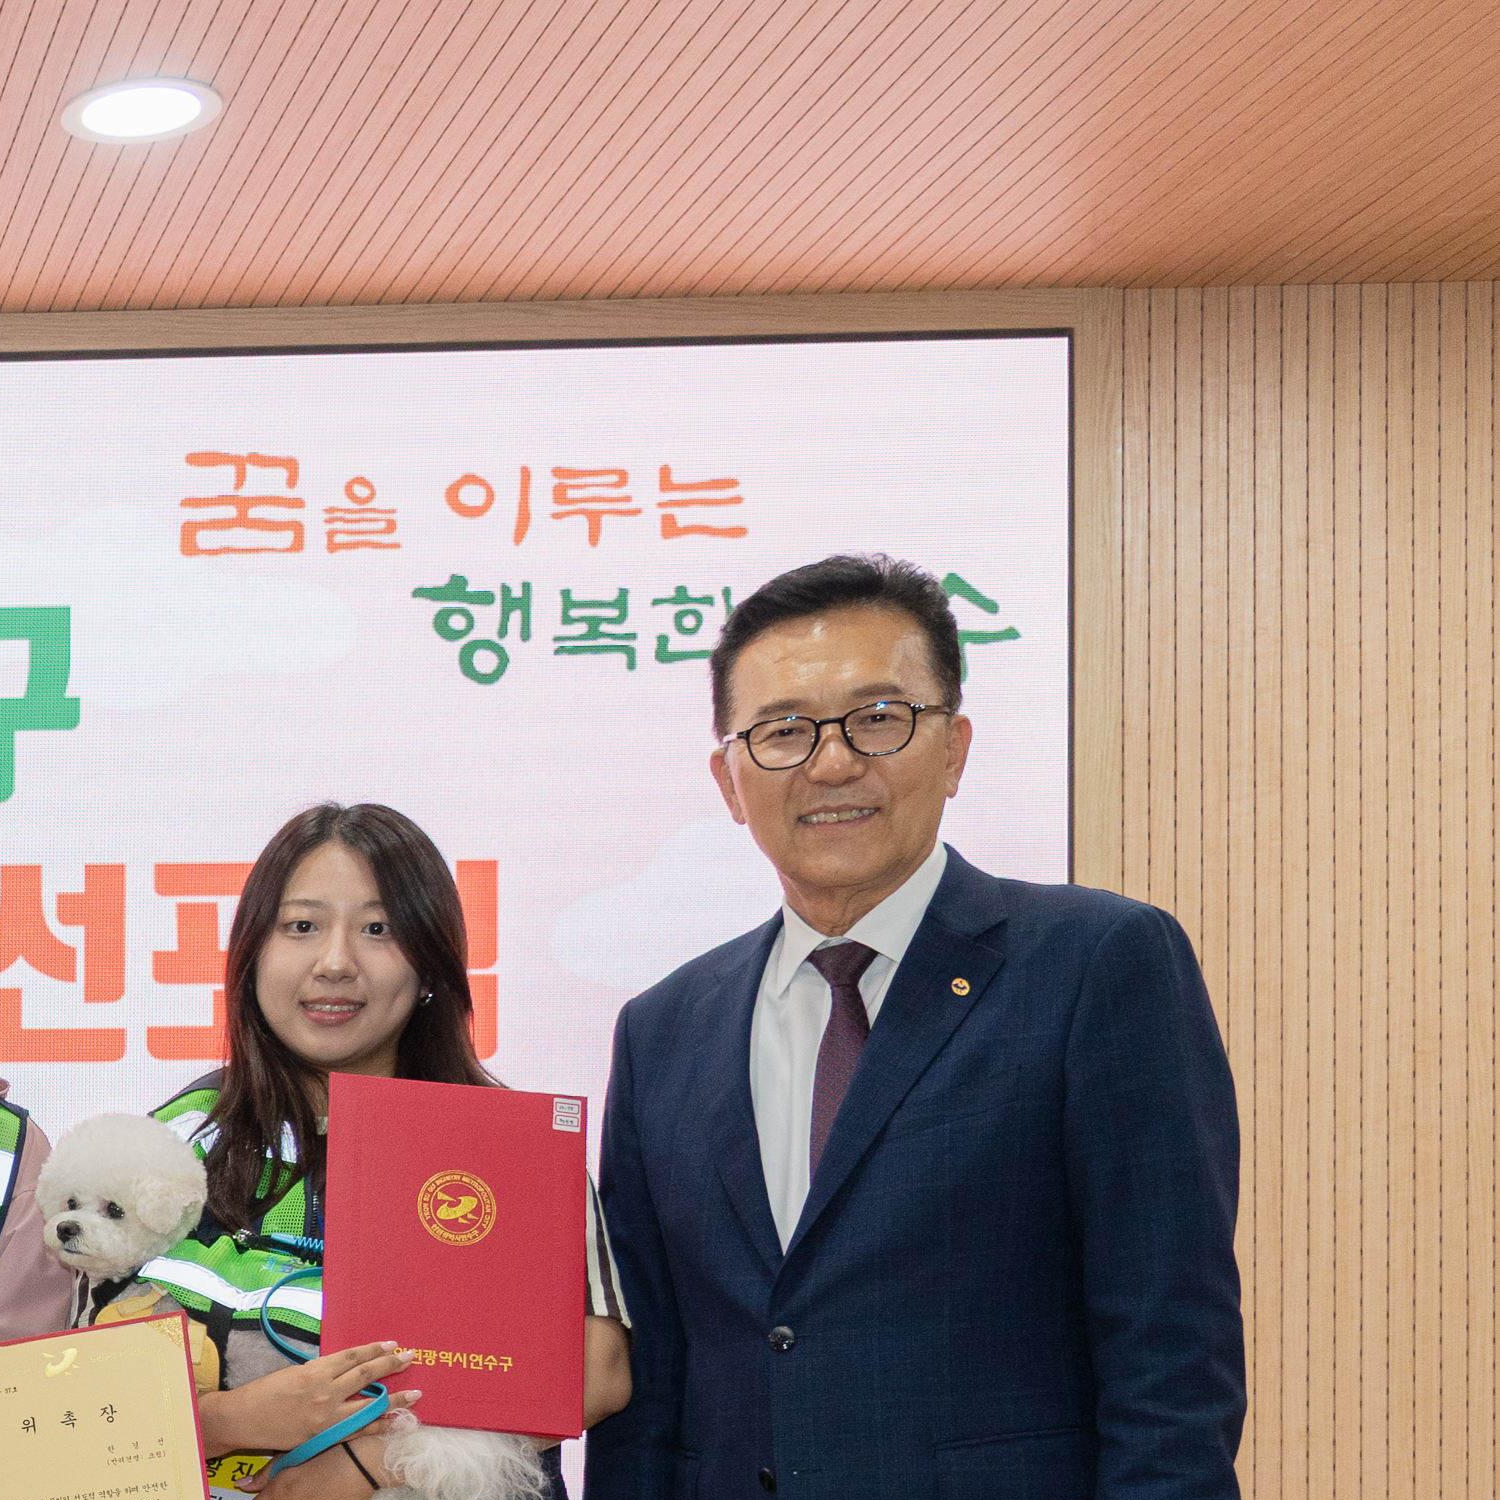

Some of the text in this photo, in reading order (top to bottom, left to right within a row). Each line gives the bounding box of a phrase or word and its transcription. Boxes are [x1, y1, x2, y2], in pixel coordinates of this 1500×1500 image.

[179, 451, 748, 557] 꿈을 이루는
[411, 574, 736, 685] 행복한
[21, 1404, 118, 1435] 위촉장
